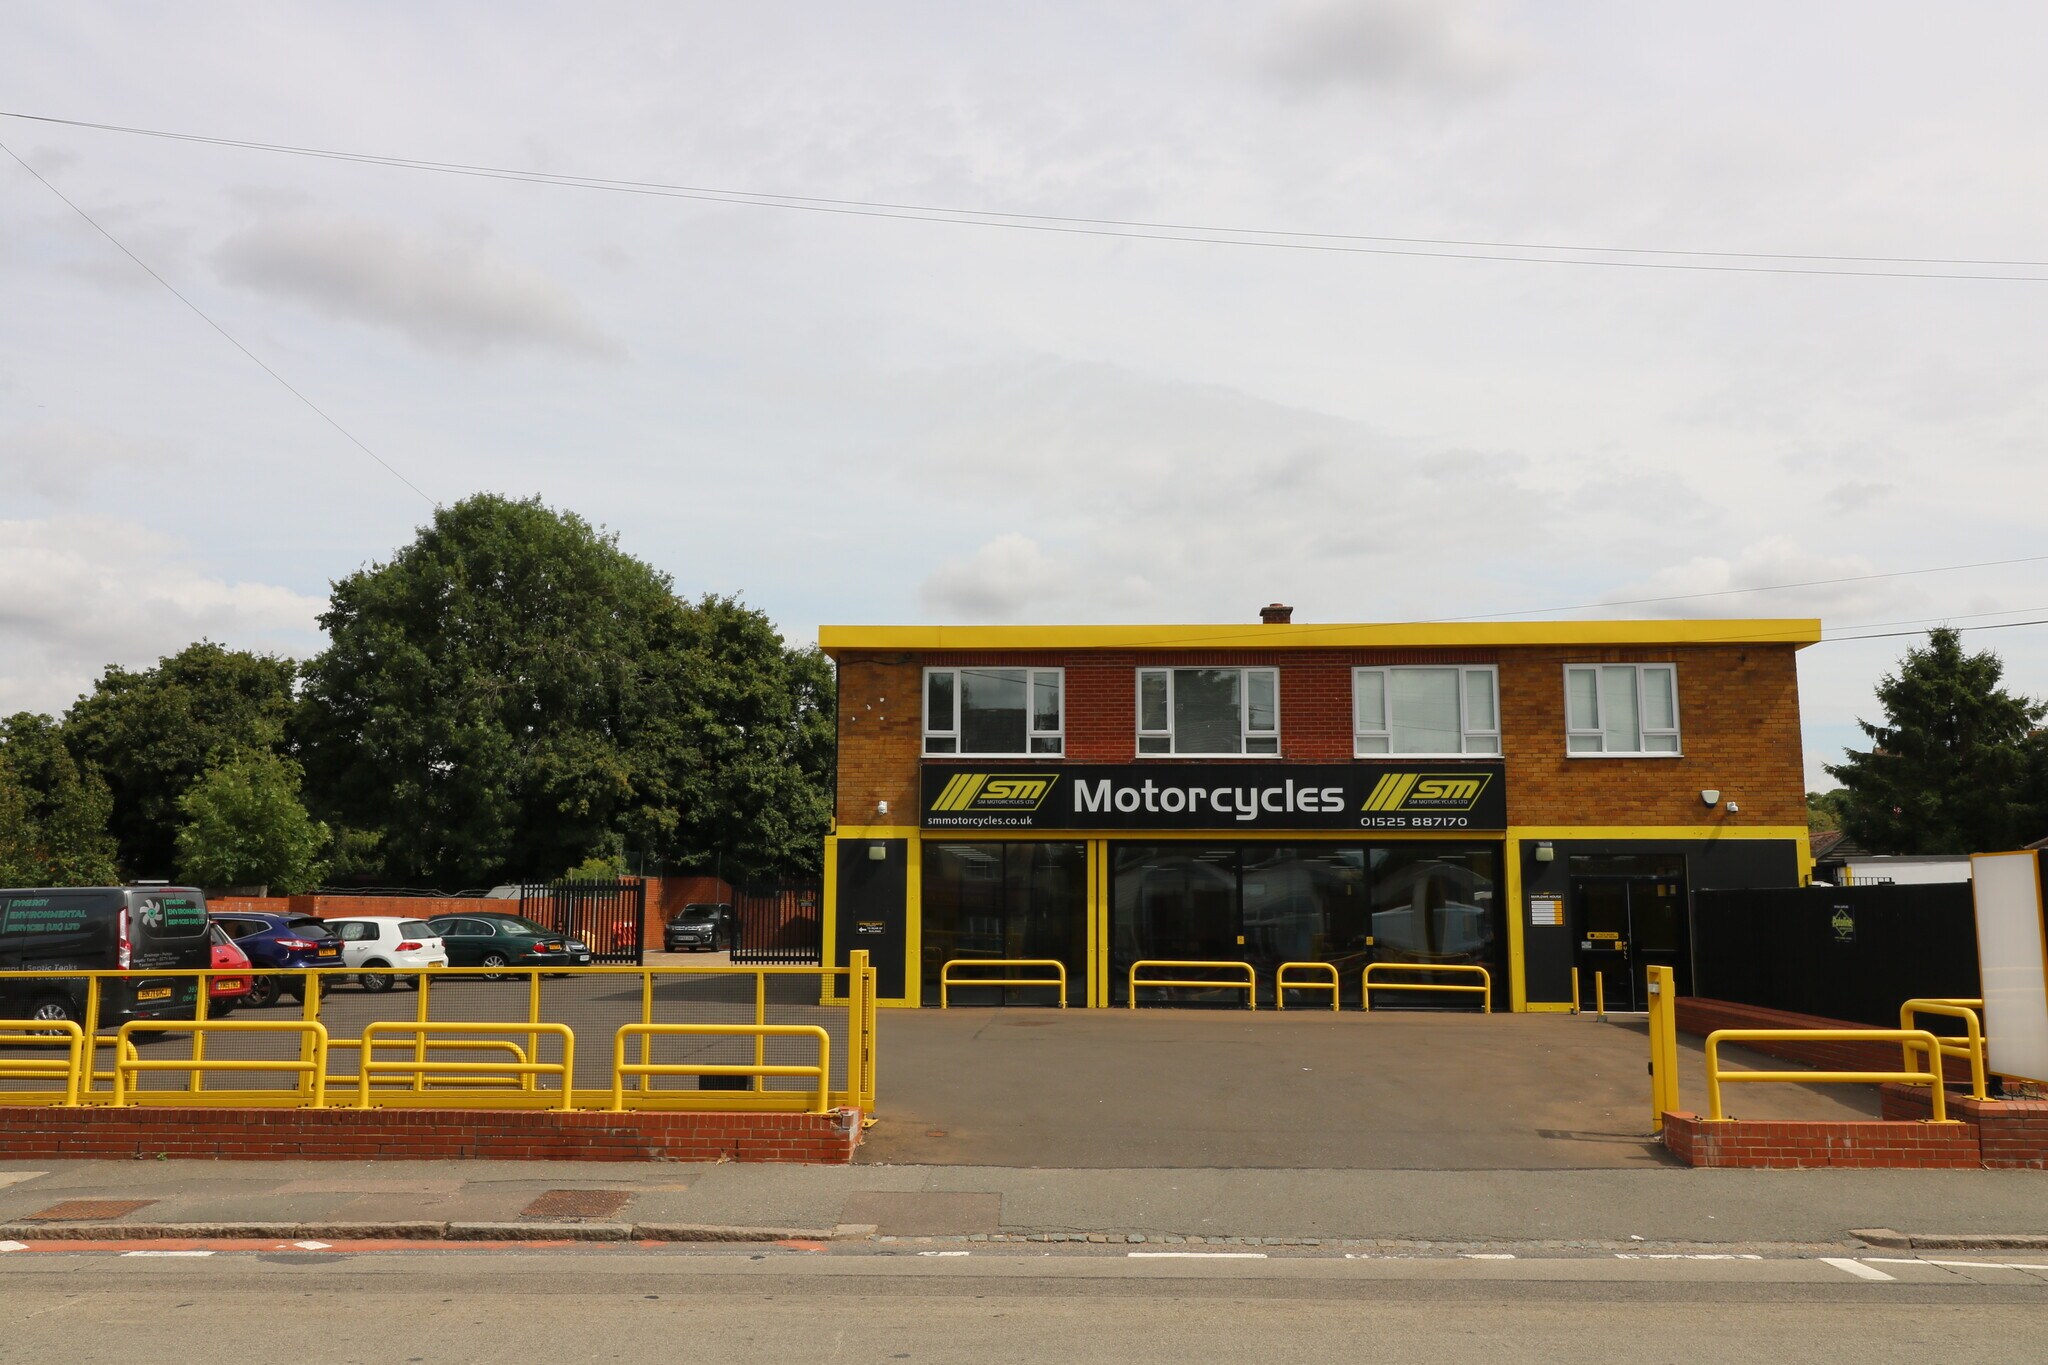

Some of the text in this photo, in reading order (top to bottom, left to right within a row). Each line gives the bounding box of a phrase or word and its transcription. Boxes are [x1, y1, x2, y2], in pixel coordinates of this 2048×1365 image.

[1074, 779, 1345, 821] Motorcycles
[928, 816, 1033, 827] smmotorcycles.co.uk
[1360, 817, 1468, 827] 01525 887170
[12, 898, 50, 907] SYNERGY
[9, 910, 87, 919] ENVIRONMENTAL
[6, 923, 45, 932] SERVICES
[64, 923, 81, 931] LTD
[27, 964, 52, 972] Septic
[53, 963, 78, 971] Tanks
